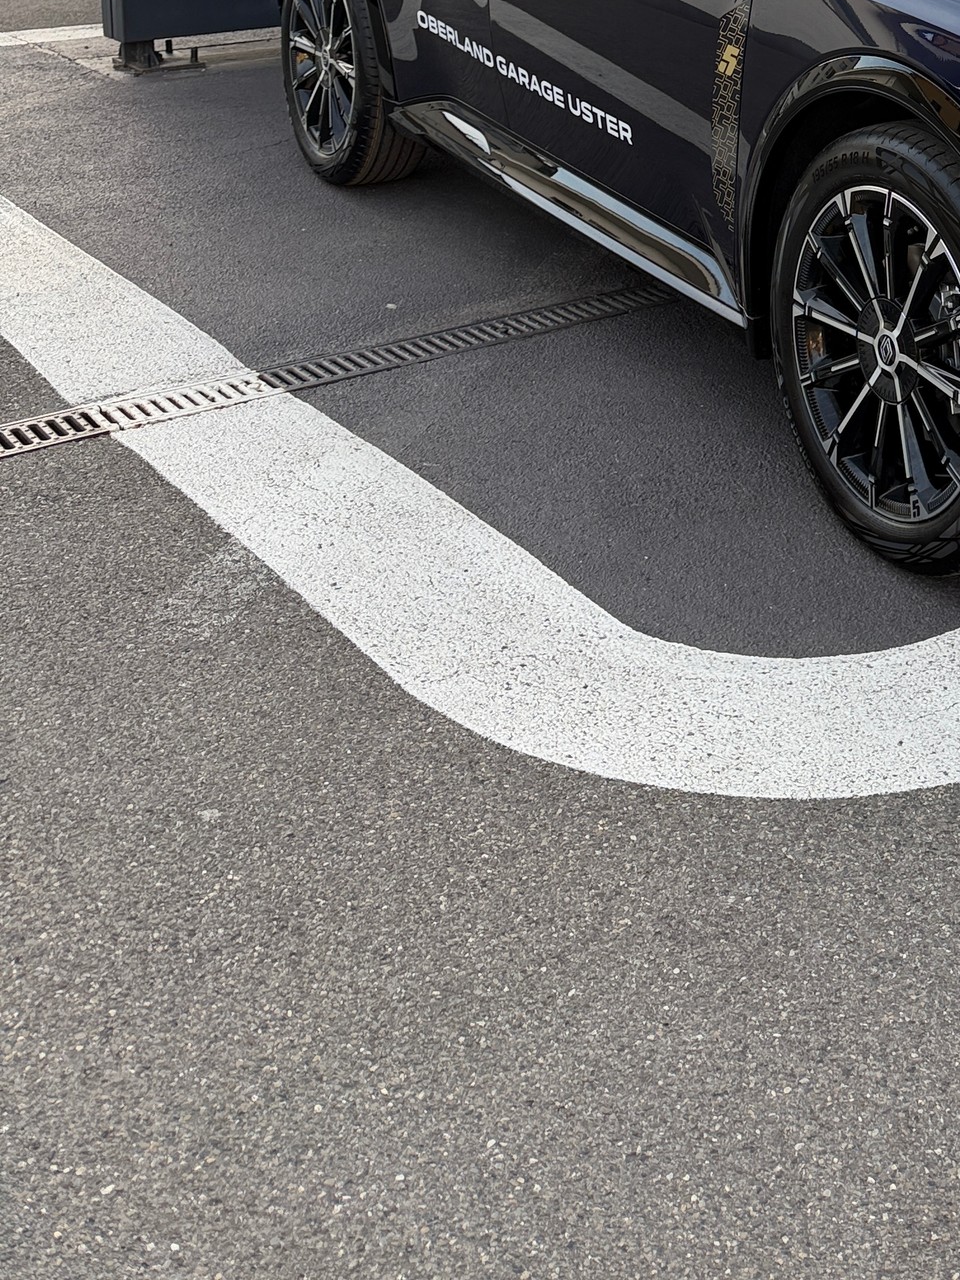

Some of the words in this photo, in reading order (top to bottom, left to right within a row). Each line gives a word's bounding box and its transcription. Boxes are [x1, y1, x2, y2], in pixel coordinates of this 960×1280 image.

[416, 10, 494, 68] OBERLAND
[495, 55, 565, 109] GARAGE
[567, 93, 634, 146] USTER
